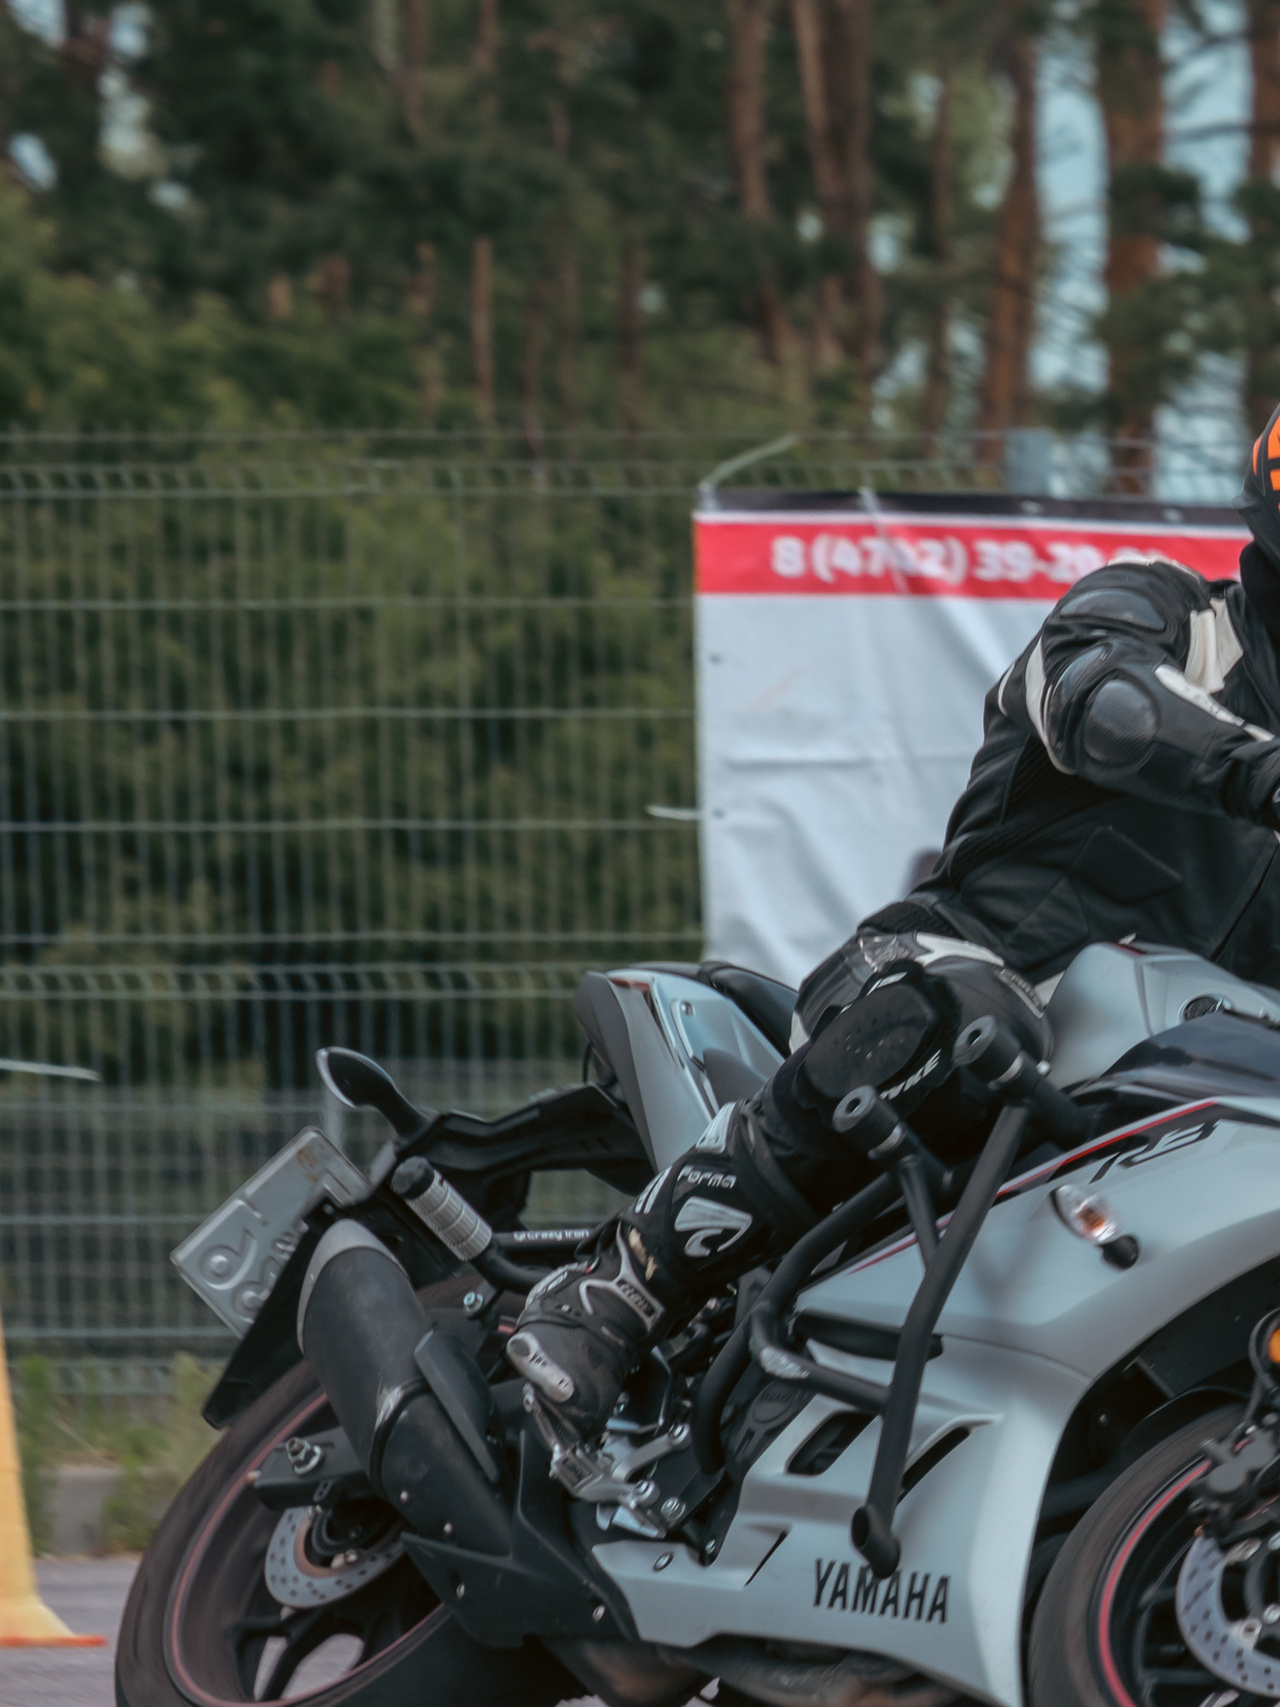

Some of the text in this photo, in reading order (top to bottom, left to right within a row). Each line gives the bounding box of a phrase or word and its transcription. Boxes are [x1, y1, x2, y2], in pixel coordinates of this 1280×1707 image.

[771, 536, 806, 579] 8
[676, 1164, 737, 1190] Forma
[813, 1557, 951, 1625] YAMAHA
